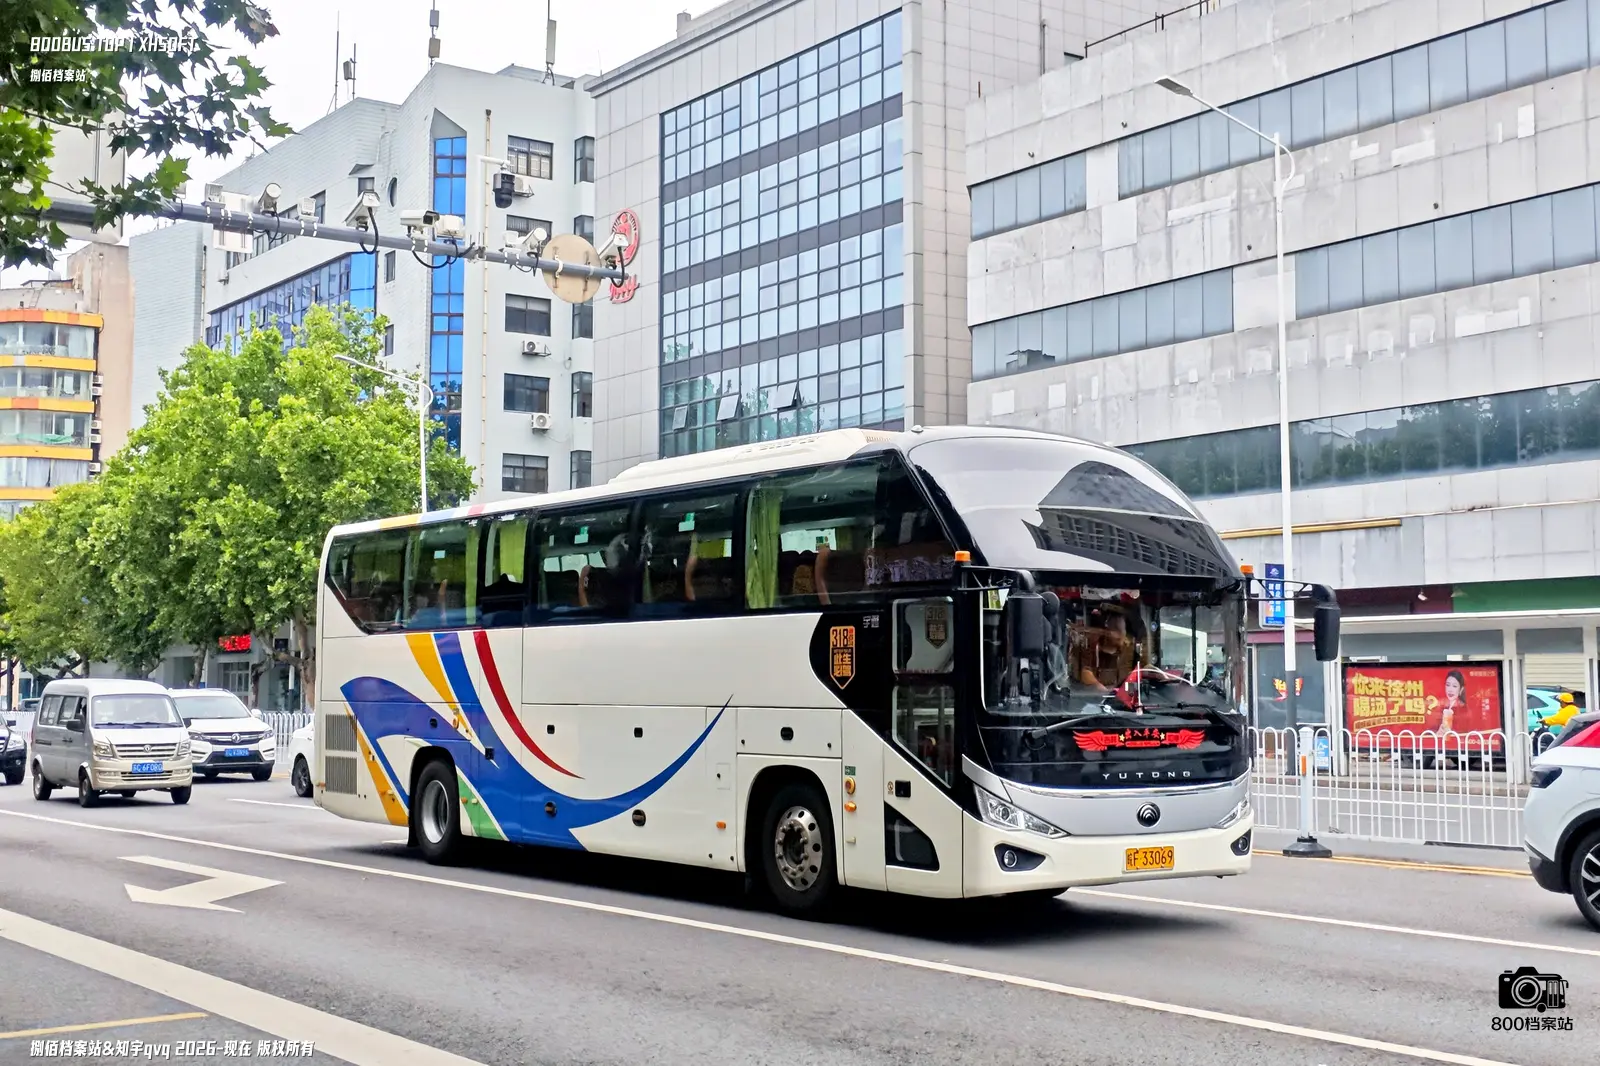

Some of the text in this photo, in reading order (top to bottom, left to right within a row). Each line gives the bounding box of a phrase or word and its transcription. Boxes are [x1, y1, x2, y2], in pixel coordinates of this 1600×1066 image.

[831, 628, 849, 647] 318
[1351, 672, 1424, 698] 你来徐州
[1102, 770, 1191, 780] YUTONG
